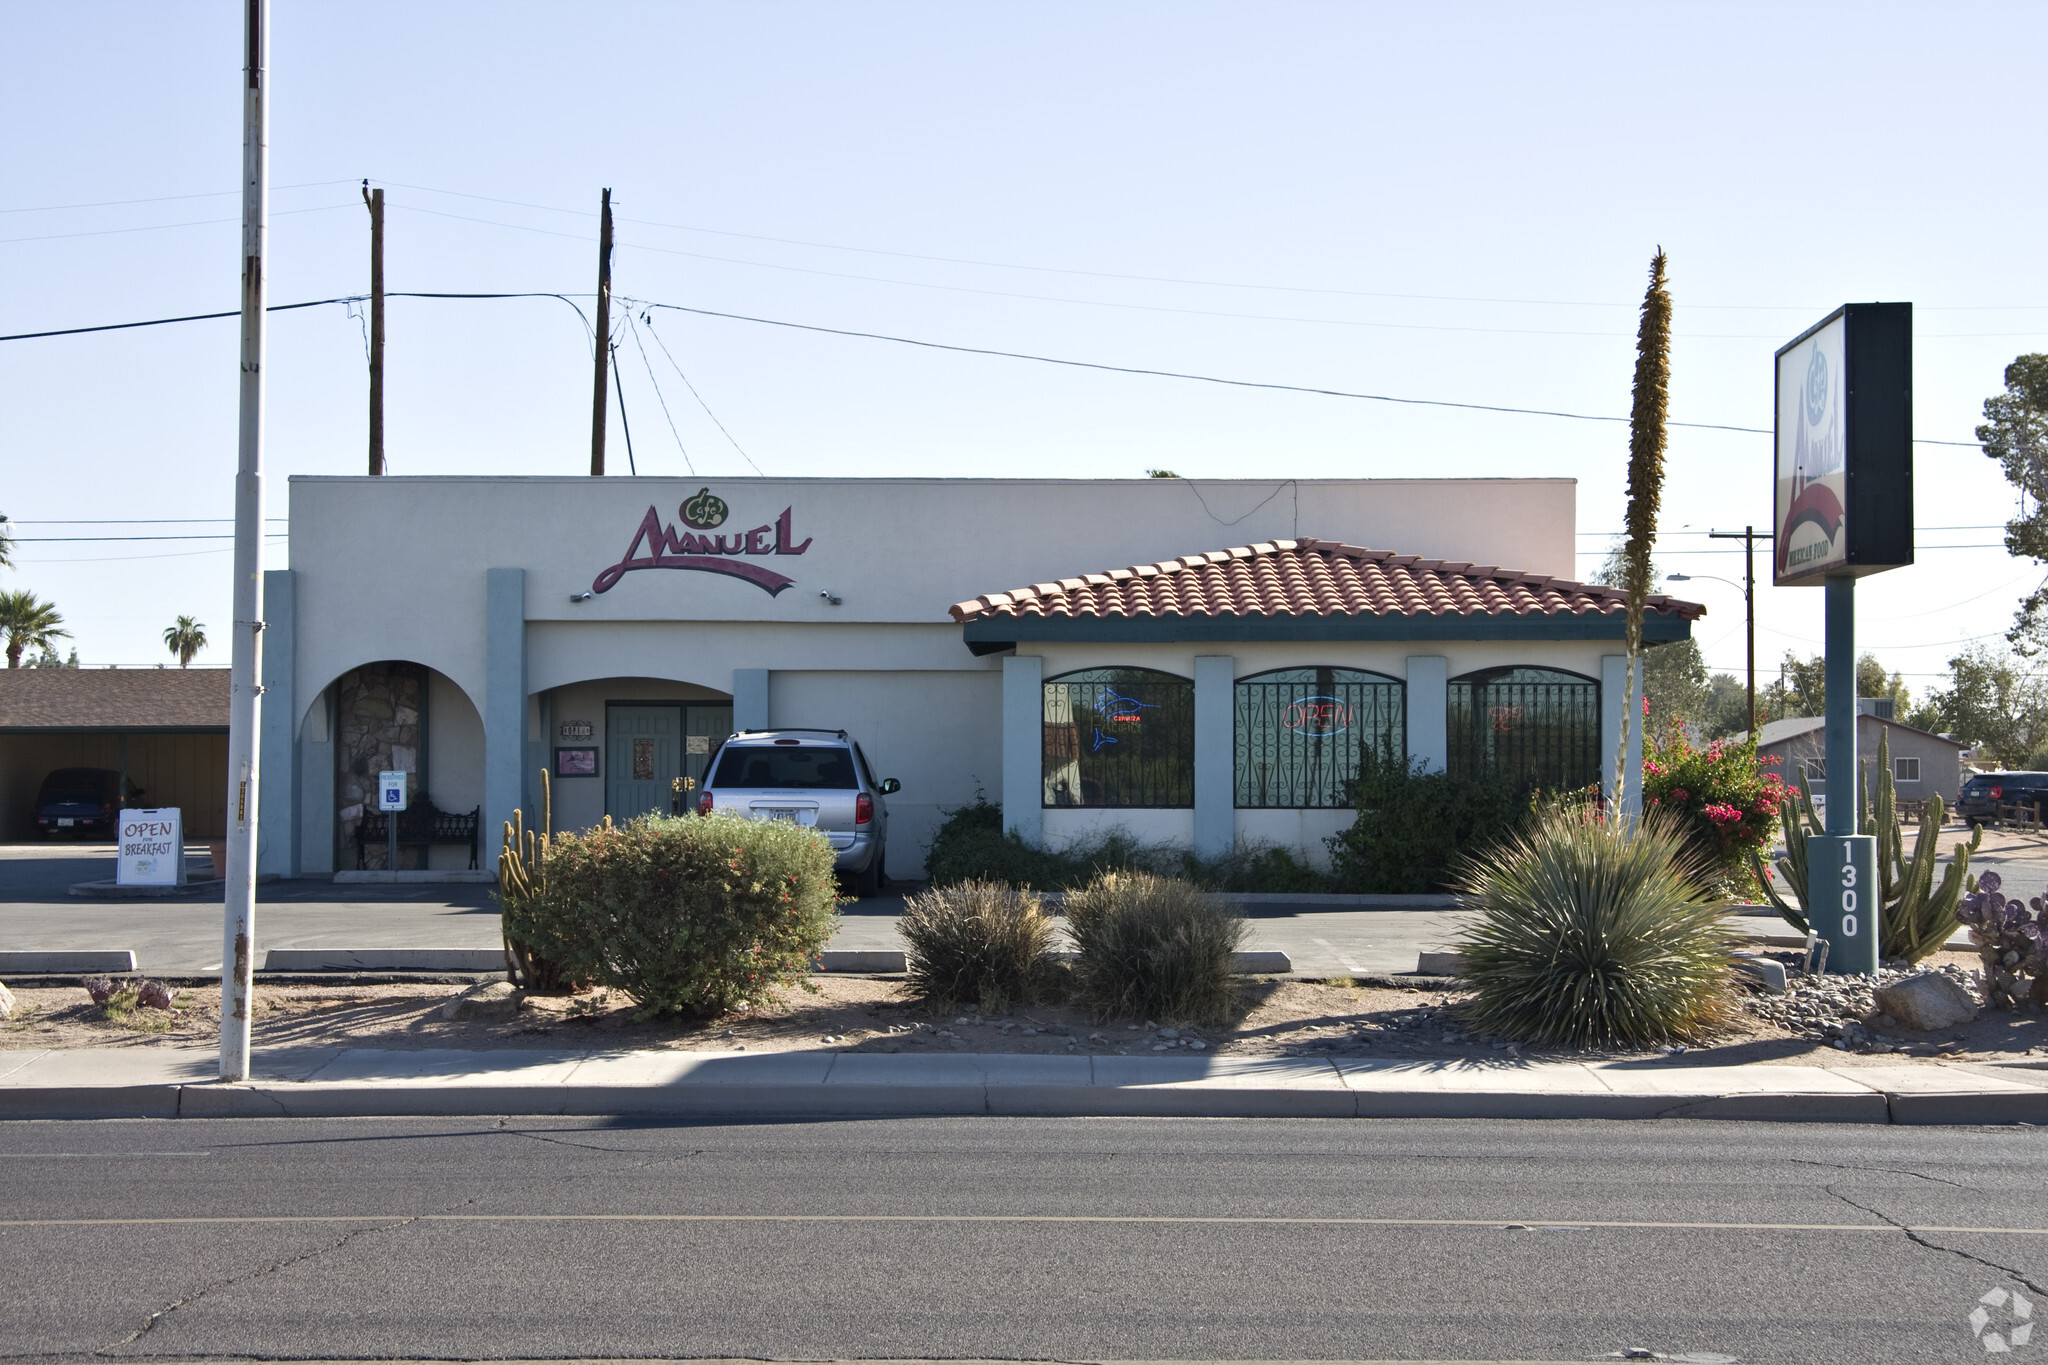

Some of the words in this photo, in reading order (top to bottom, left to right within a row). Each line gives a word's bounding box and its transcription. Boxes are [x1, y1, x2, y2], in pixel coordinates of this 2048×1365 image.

[604, 504, 813, 566] MANUEL
[1789, 544, 1812, 567] MEXICAN
[1814, 539, 1828, 560] FOOD
[1283, 704, 1353, 728] OPEN
[124, 822, 172, 837] OPEN
[125, 842, 172, 856] BREAKFAST
[1841, 841, 1858, 936] 1300
